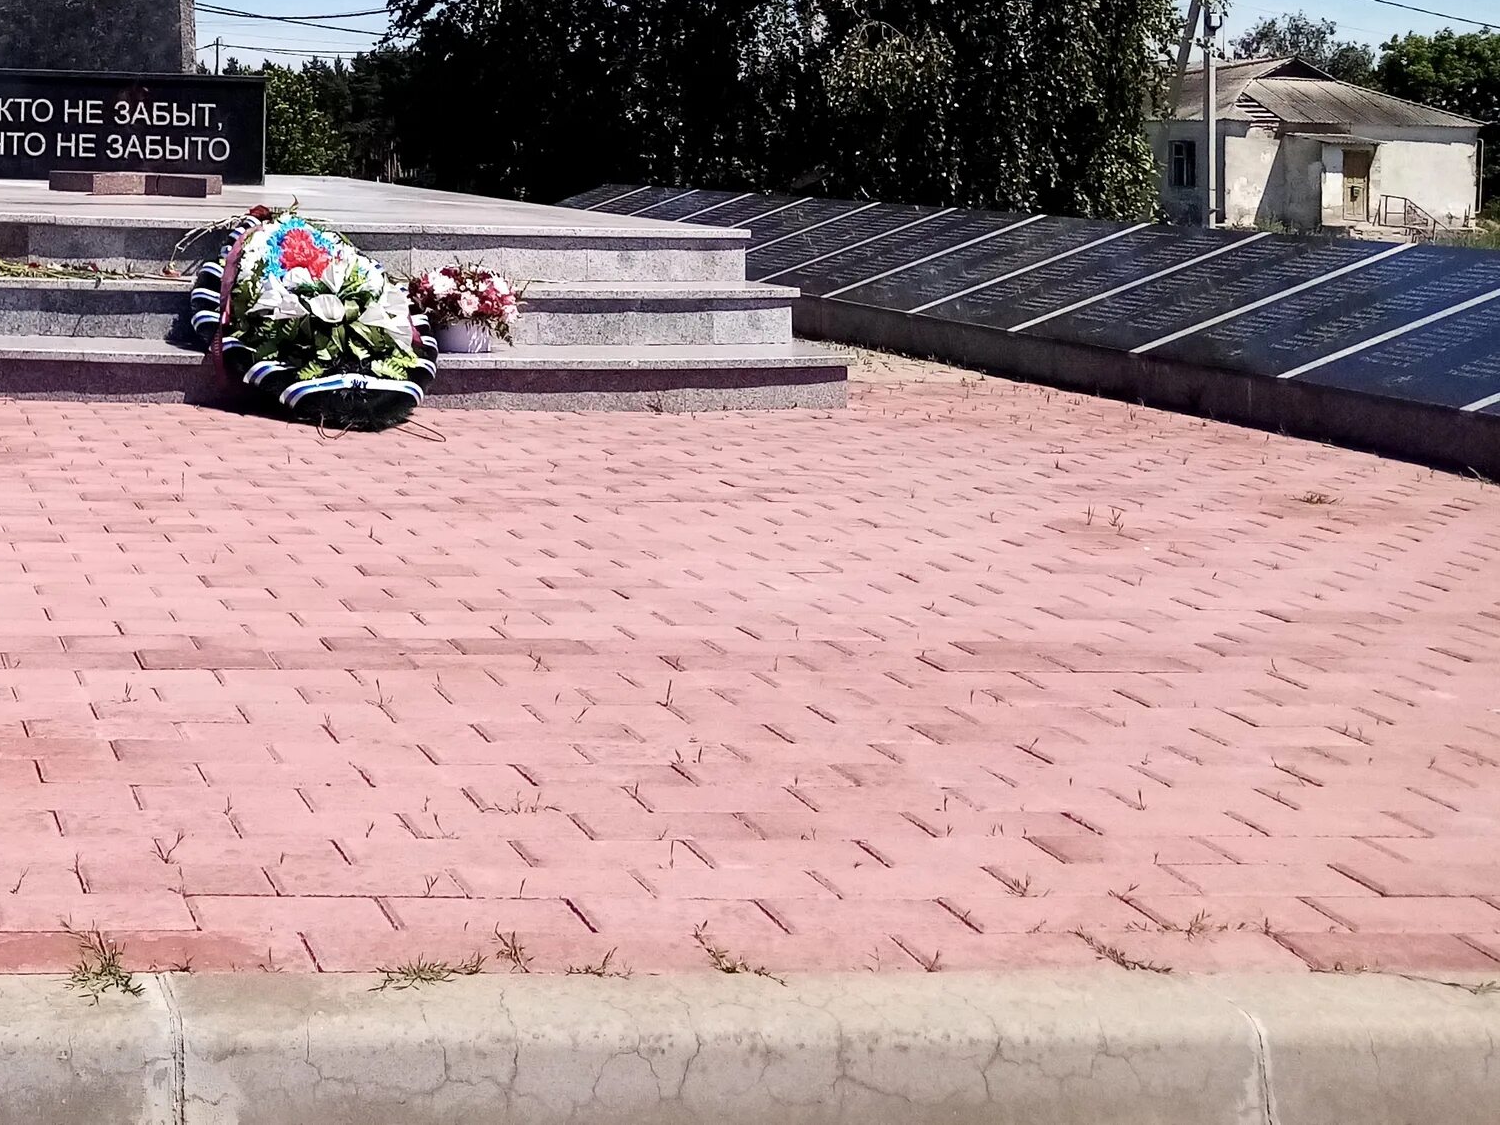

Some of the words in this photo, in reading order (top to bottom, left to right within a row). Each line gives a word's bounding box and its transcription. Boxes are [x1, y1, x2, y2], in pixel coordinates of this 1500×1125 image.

[64, 99, 104, 124] НЕ
[114, 100, 223, 131] ЗАБЫТ,
[56, 132, 97, 158] НЕ
[105, 134, 230, 162] ЗАБЫТО
